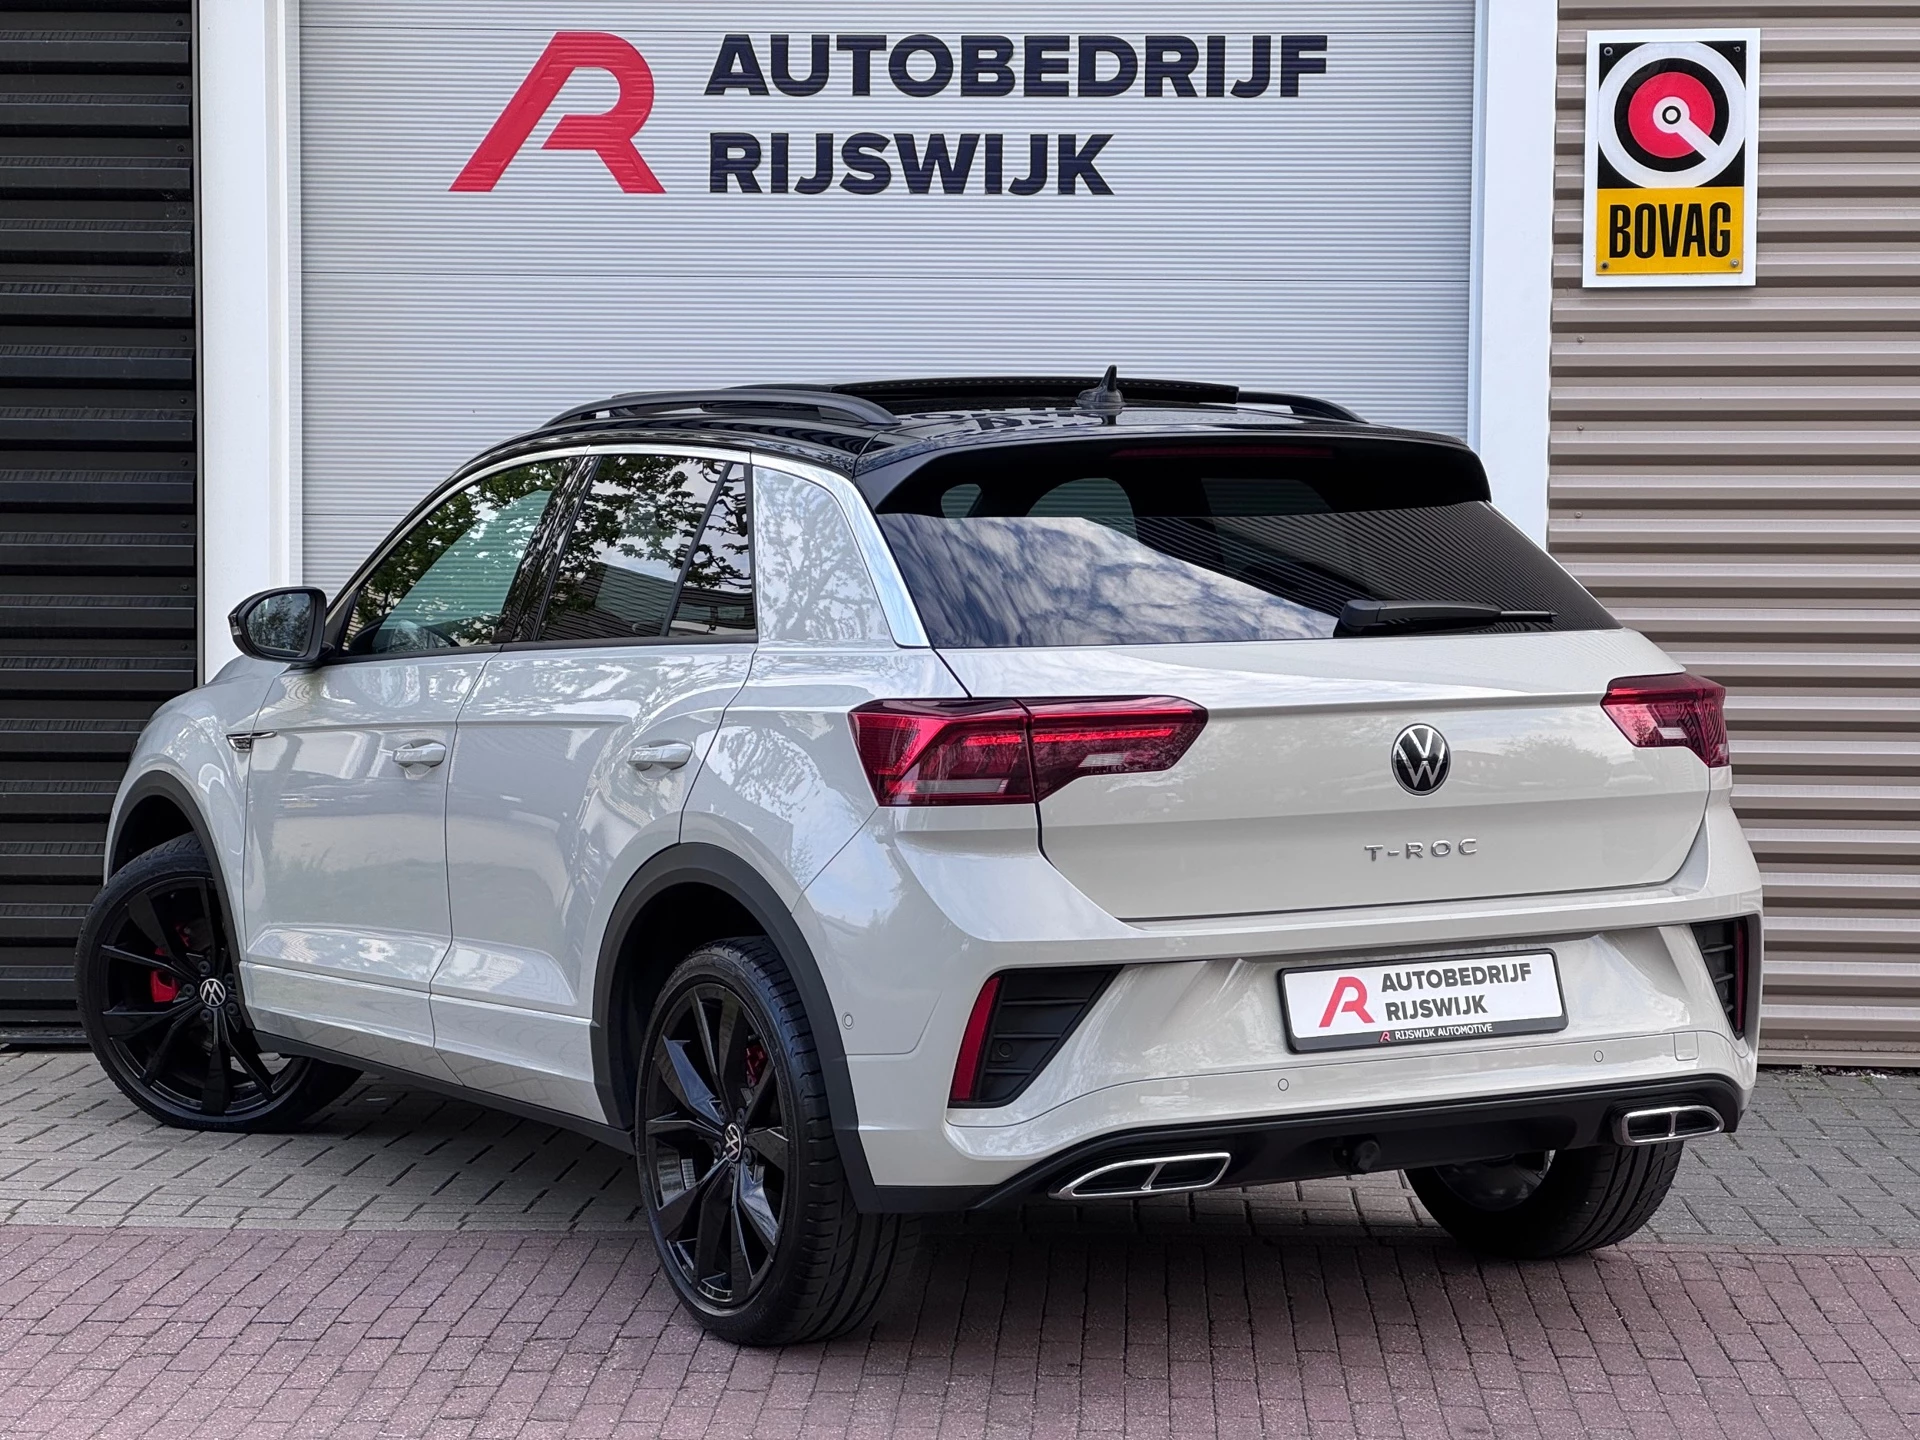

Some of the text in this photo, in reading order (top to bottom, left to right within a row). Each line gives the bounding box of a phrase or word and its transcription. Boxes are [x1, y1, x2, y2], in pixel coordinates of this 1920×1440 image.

[704, 33, 1328, 98] AUTOBEDRIJF
[709, 132, 1114, 196] RIJSWIJK
[1608, 201, 1731, 258] BOVAG
[1364, 838, 1478, 862] T-ROC
[1381, 962, 1532, 993] AUTOBEDRIJF
[1385, 995, 1488, 1021] RIJSWIJK
[1394, 1029, 1436, 1041] RIJSWIJK
[1437, 1023, 1493, 1037] AUTOMOTIVE
